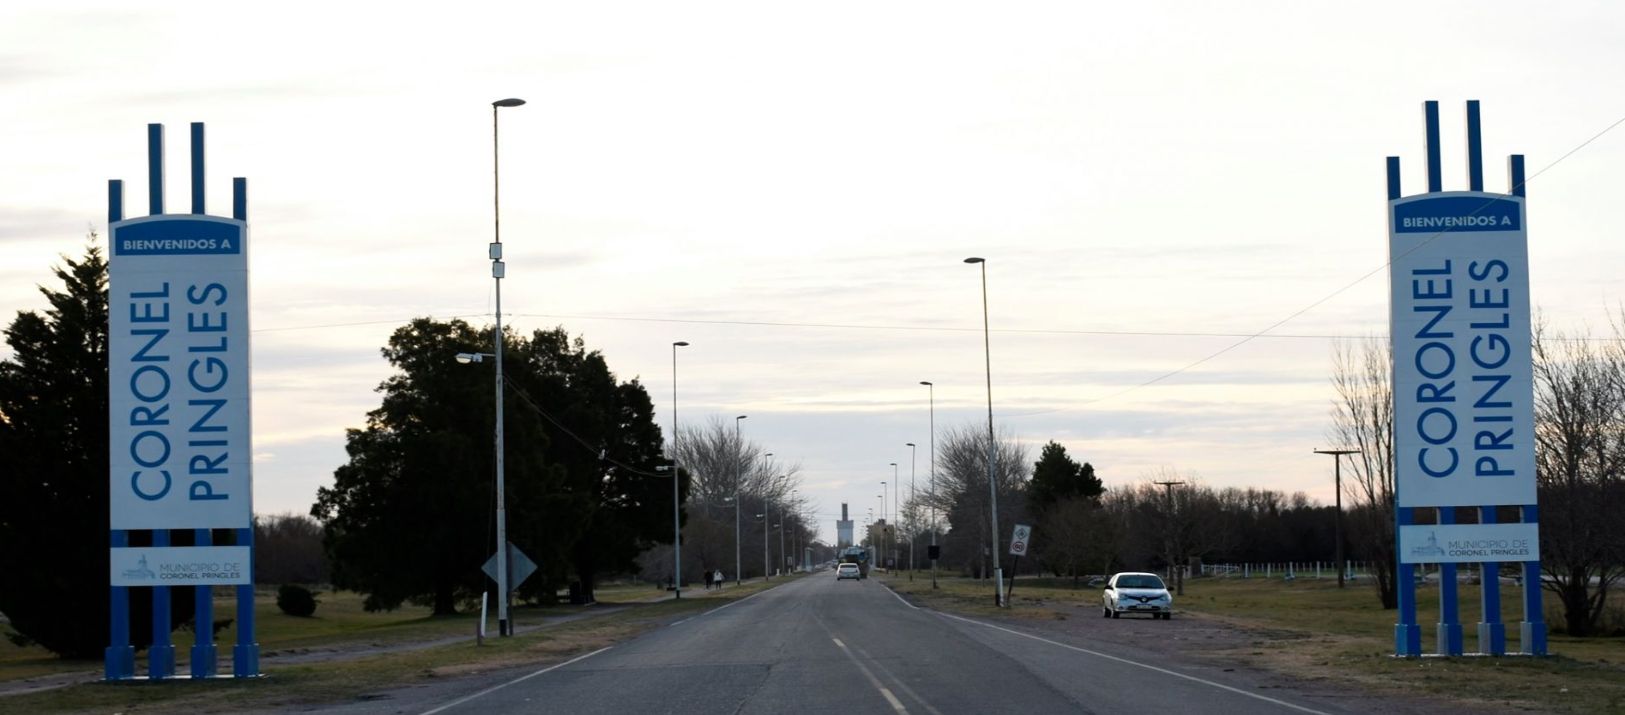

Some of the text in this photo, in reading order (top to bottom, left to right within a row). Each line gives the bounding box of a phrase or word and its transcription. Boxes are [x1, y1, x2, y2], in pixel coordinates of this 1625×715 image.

[1403, 215, 1512, 228] BIENVENIDOS A
[123, 239, 232, 251] BIENVENIDOS A
[1412, 259, 1459, 478] CORONEL
[1468, 259, 1515, 477] PRINGLES
[129, 282, 172, 501] CORONEL
[187, 282, 229, 501] PRINGLES
[1448, 539, 1529, 549] MUNICIPIO DE
[1448, 548, 1529, 557] CORONEL PRINGLES
[160, 562, 240, 572] MUNICIPIO DE
